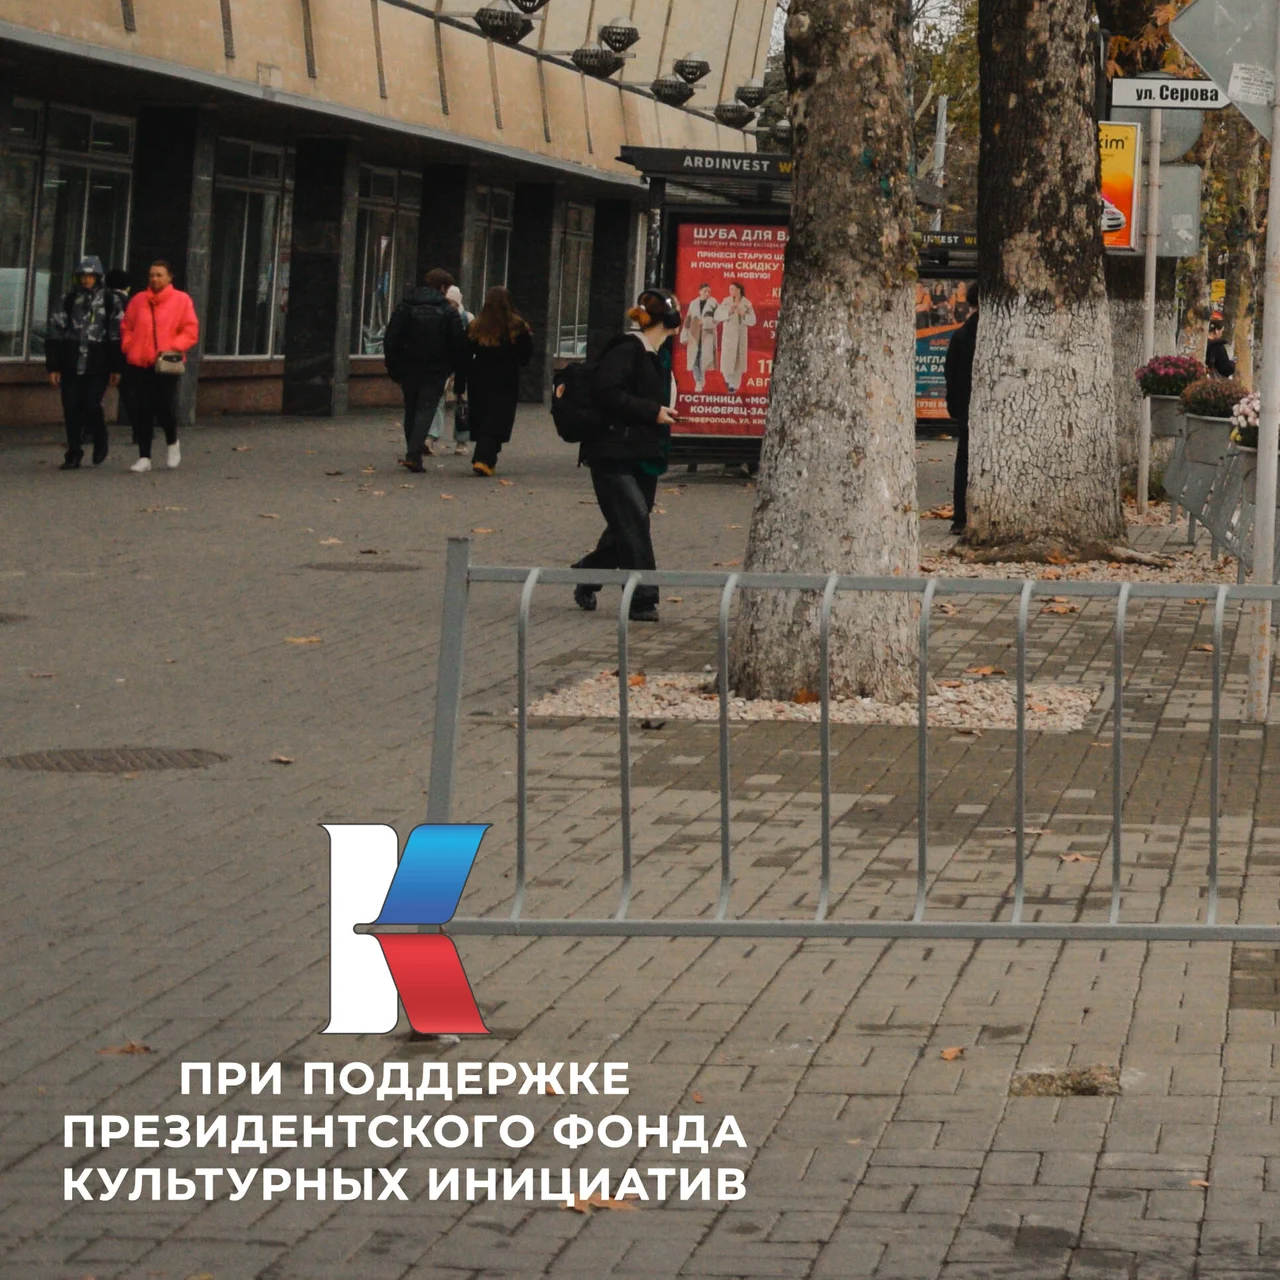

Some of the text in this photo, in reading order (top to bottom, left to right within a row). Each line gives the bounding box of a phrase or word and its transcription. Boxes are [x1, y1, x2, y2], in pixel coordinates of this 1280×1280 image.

[1136, 85, 1219, 101] ул. Серова
[683, 155, 770, 172] ARDINVEST
[693, 228, 789, 241] ШУБА ДЛЯ В
[697, 250, 736, 258] ПРИНЕСИ
[737, 252, 773, 261] СТАРУЮ
[699, 261, 734, 269] ПОЛУЧИ
[735, 261, 779, 271] СКИДКУ
[723, 271, 736, 279] НА
[679, 394, 743, 405] ГОСТИНИЦА
